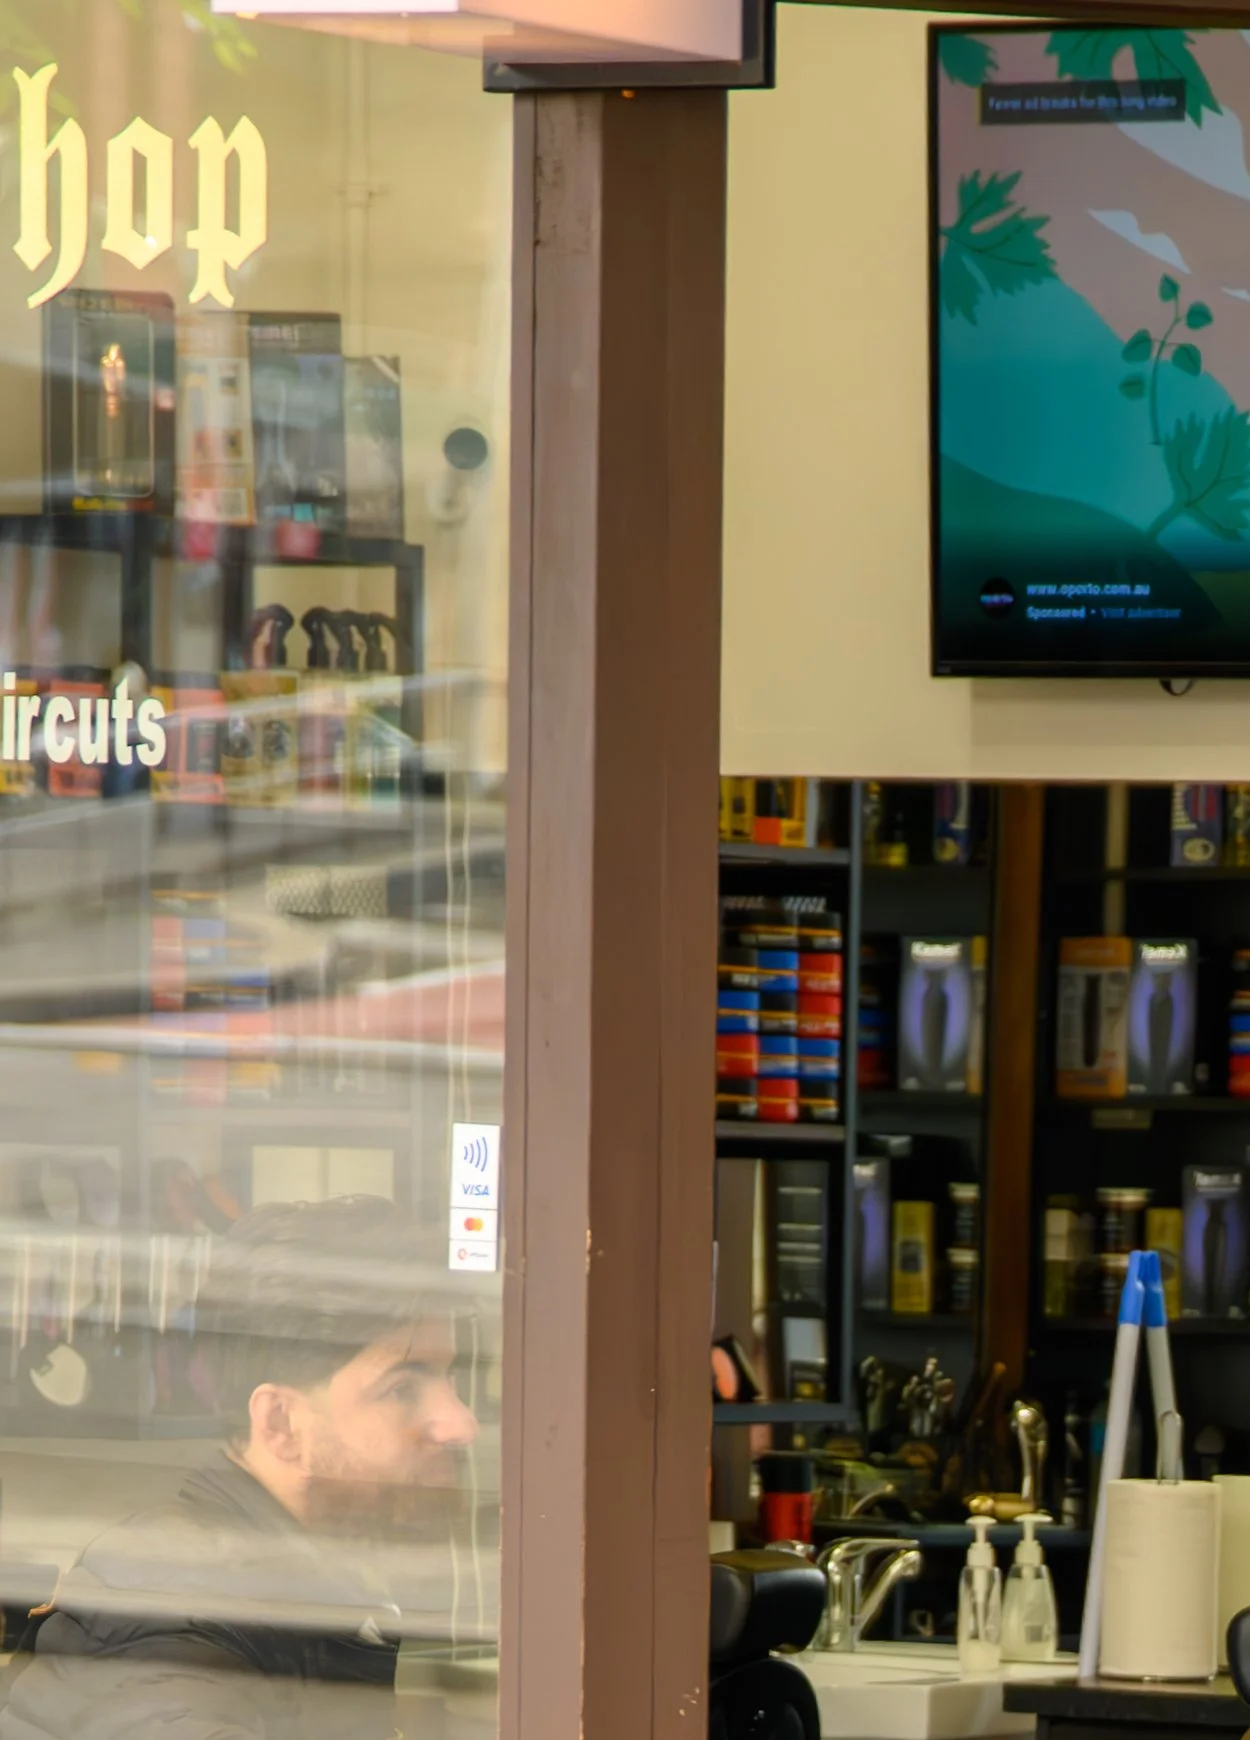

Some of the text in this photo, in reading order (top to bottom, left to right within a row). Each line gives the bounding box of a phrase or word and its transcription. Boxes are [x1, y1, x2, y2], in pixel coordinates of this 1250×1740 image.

[13, 62, 268, 308] hop
[1, 672, 166, 766] ircuts
[462, 1184, 490, 1196] VISA
